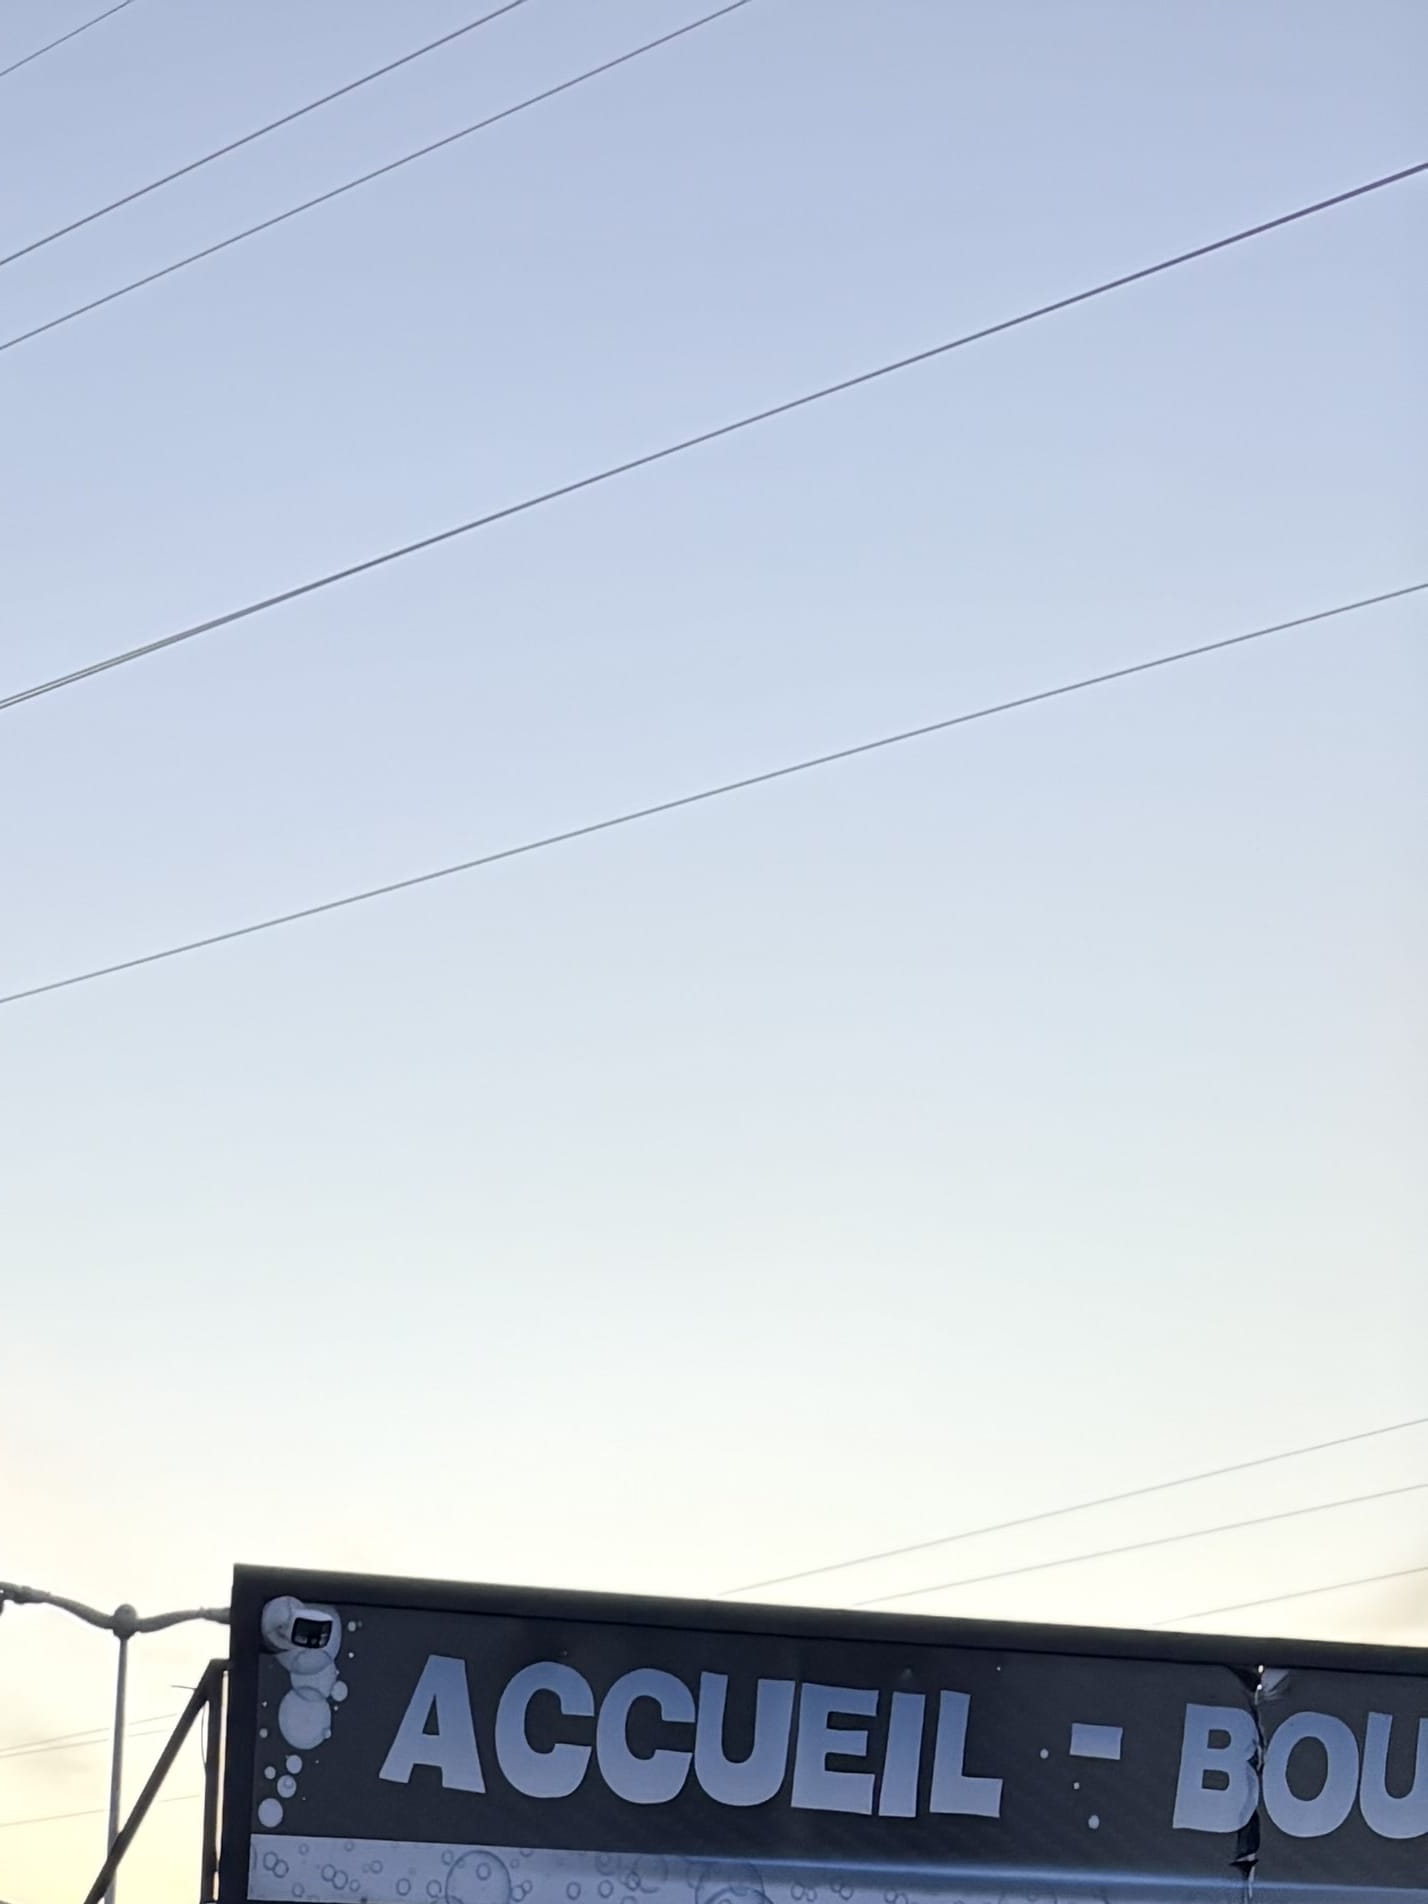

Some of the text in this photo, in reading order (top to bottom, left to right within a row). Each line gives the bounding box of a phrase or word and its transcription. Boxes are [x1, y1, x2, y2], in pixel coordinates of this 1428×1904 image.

[379, 1653, 1428, 1839] ACCUEIL - BOU
